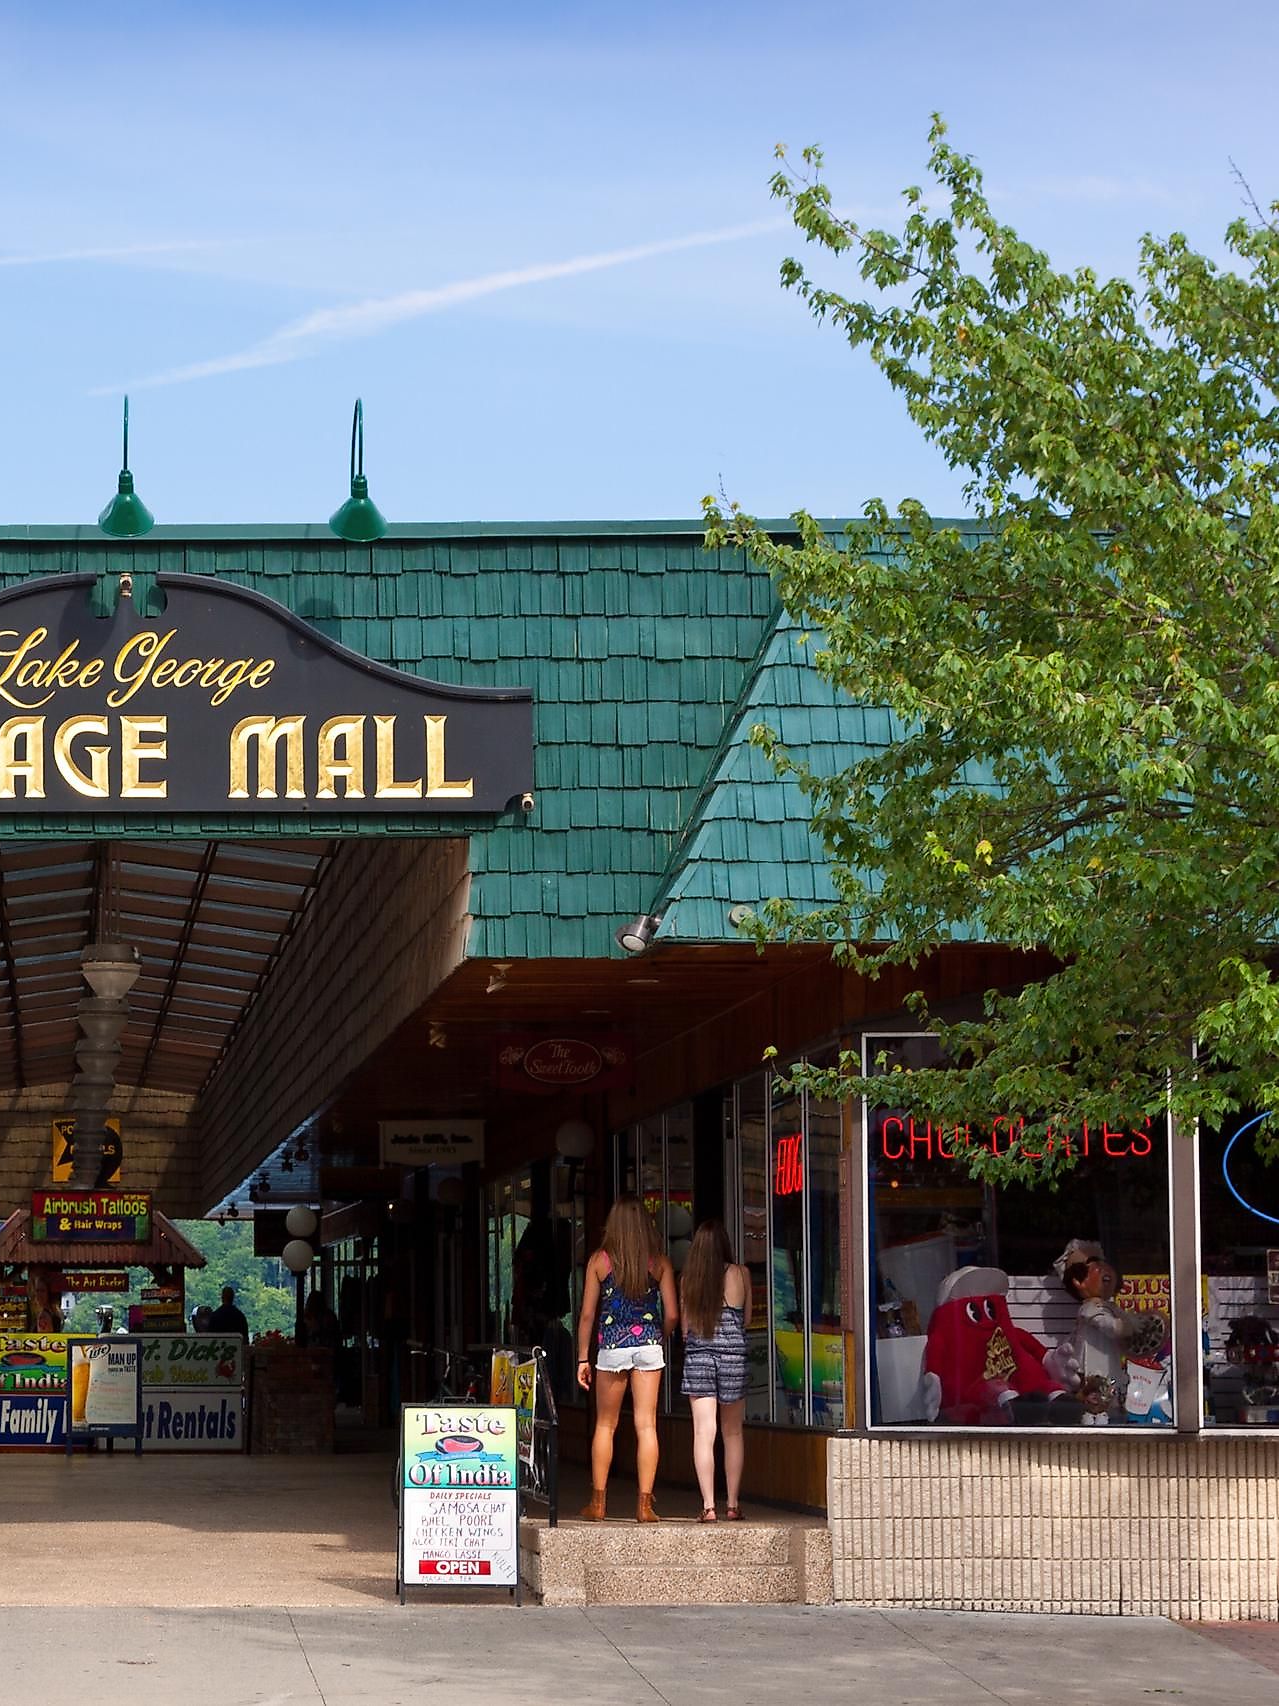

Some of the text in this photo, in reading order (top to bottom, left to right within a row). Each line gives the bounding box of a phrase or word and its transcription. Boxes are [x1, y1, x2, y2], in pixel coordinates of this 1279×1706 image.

[106, 628, 276, 707] George
[227, 715, 474, 801] MALL
[548, 1043, 571, 1058] The
[883, 1116, 1152, 1161] CHOOLATES
[43, 1198, 97, 1215] Airbrush
[59, 1218, 122, 1232] & Hair Wraps
[66, 1277, 80, 1288] The
[1120, 1279, 1170, 1295] SLUS
[168, 1339, 237, 1362] Dick's
[108, 1353, 137, 1366] MAN UP
[0, 1398, 58, 1444] Family
[157, 1399, 236, 1440] Rentals
[416, 1412, 506, 1436] Taste
[408, 1462, 512, 1487] Of India
[430, 1492, 493, 1500] DAILY SPECIALS
[429, 1502, 506, 1515] SAMOSA CHAT
[459, 1514, 494, 1527] POORI
[416, 1527, 504, 1539] CHICKEN WINGS
[464, 1538, 486, 1548] CHAT
[423, 1550, 481, 1560] MANGO LASSI
[436, 1560, 480, 1575] OPEN
